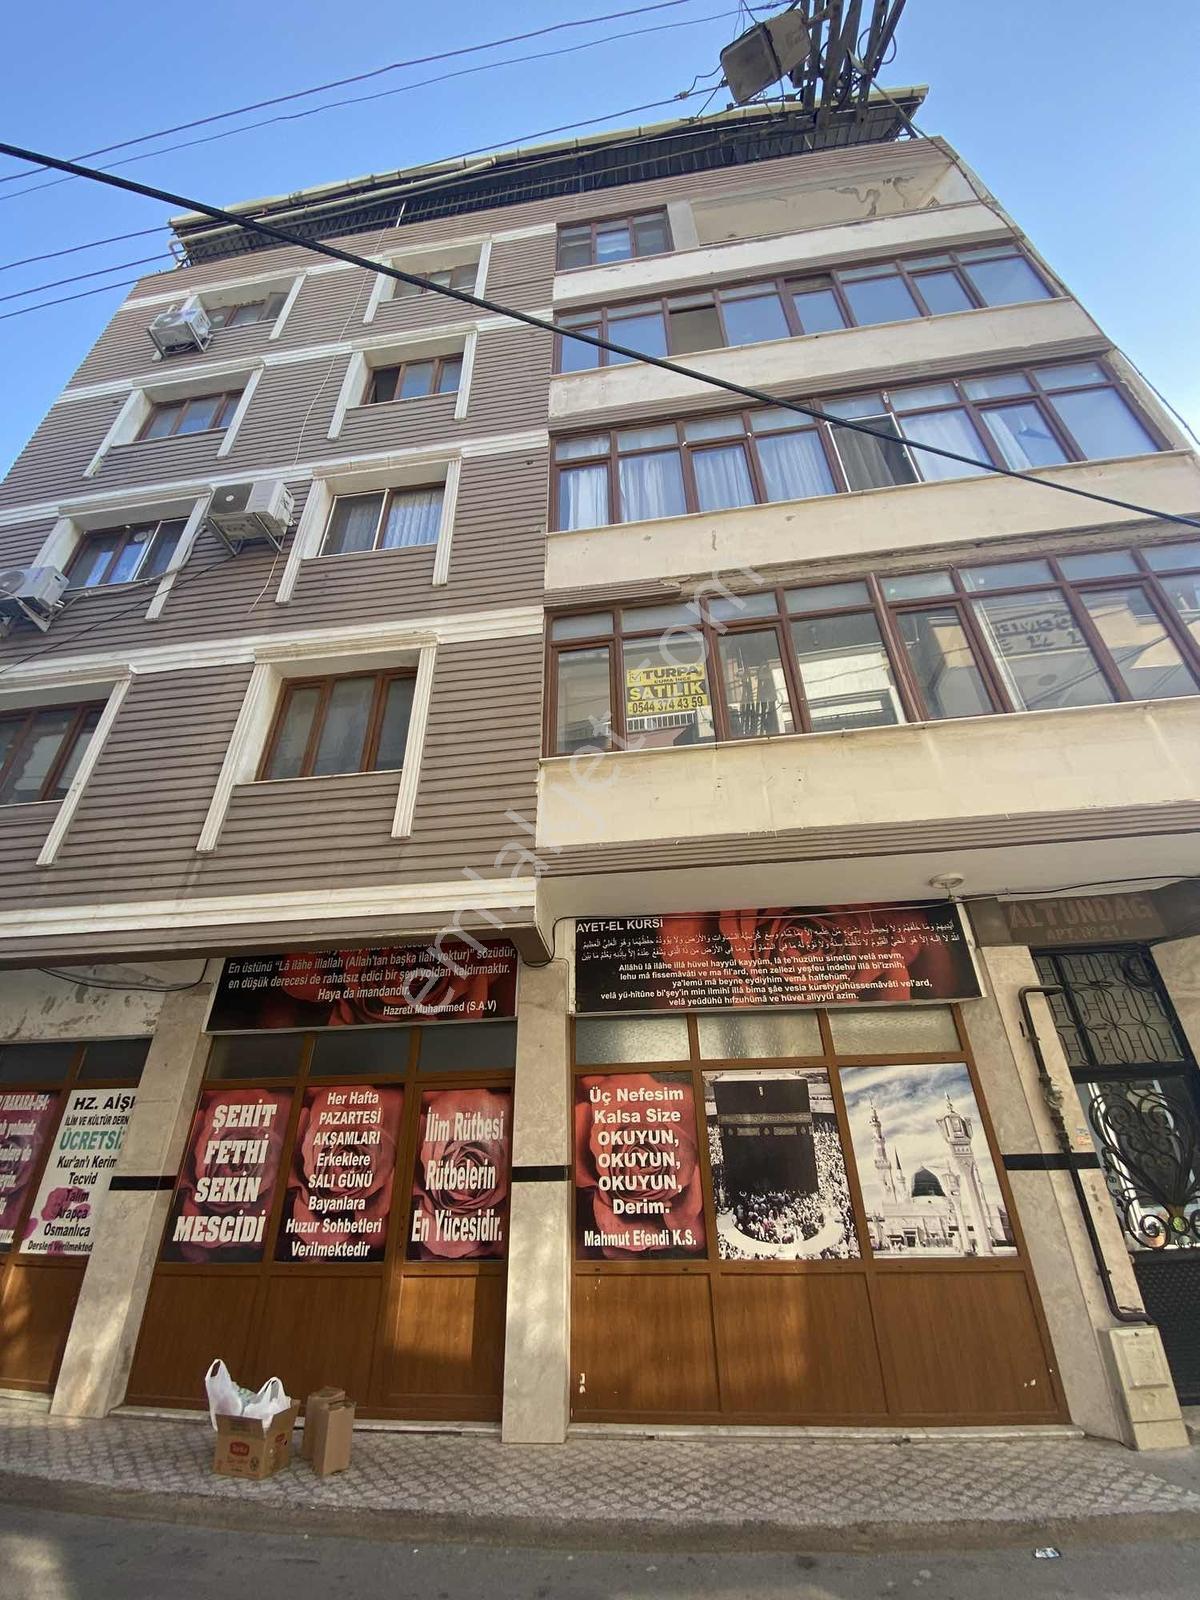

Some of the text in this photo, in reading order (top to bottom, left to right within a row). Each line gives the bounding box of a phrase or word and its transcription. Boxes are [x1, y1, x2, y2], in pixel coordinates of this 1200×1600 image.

[630, 681, 704, 701] SATILIK
[632, 701, 655, 714] 0544
[678, 698, 689, 709] 43
[692, 696, 703, 708] 59
[575, 921, 625, 933] AYET-EL
[228, 961, 240, 974] En
[242, 960, 273, 974] üstünü
[314, 956, 344, 970] illallah
[390, 952, 417, 967] başka
[750, 968, 769, 976] men
[827, 961, 856, 972] indehu
[228, 979, 240, 990] en
[242, 977, 268, 991] düşük
[270, 974, 309, 988] derecesi
[310, 973, 321, 985] de
[323, 971, 360, 985] rahatsız
[361, 968, 384, 982] edici
[385, 968, 398, 981] bir
[419, 966, 452, 982] yoldan
[719, 976, 744, 987] beyne
[318, 988, 341, 1002] Haya
[343, 987, 354, 999] da
[690, 987, 706, 996] min
[383, 1004, 413, 1016] Hazreti
[414, 1002, 465, 1014] Muhammed
[73, 1096, 99, 1111] HZ.
[327, 1091, 379, 1105] Her Hafta
[589, 1086, 684, 1106] Üç Nefesim
[79, 1115, 88, 1126] VE
[87, 1113, 113, 1126] KÜLTÜR
[212, 1099, 278, 1134] ŞEHİT
[319, 1107, 382, 1125] PAZARTESİ
[425, 1106, 504, 1142] İlim Rütbesi
[594, 1108, 681, 1124] Kalsa Size
[59, 1126, 126, 1150] ÜCRETSİ
[313, 1131, 380, 1149] AKŞAMLARI
[597, 1129, 679, 1147] OKUYUN,
[203, 1133, 269, 1164] FETHİ
[316, 1152, 371, 1167] Erkeklere
[598, 1151, 681, 1170] OKUYUN,
[68, 1172, 99, 1185] Tecvid
[308, 1170, 373, 1189] SALI GÜNÜ
[425, 1159, 497, 1191] Rütbelerin
[598, 1174, 683, 1193] OKUYUN,
[194, 1171, 262, 1203] SEKİN
[56, 1206, 89, 1222] Arapça
[308, 1196, 366, 1215] Bayanlara
[613, 1199, 670, 1215] Derim.
[44, 1222, 91, 1237] Osmanlıca
[172, 1209, 267, 1243] MESCİDİ
[285, 1217, 383, 1234] Huzur Sohbetleri
[411, 1208, 503, 1242] En Yücesidir.
[584, 1229, 697, 1247] Mahmut Efendi K.S.
[291, 1241, 371, 1258] Verilmektedir
